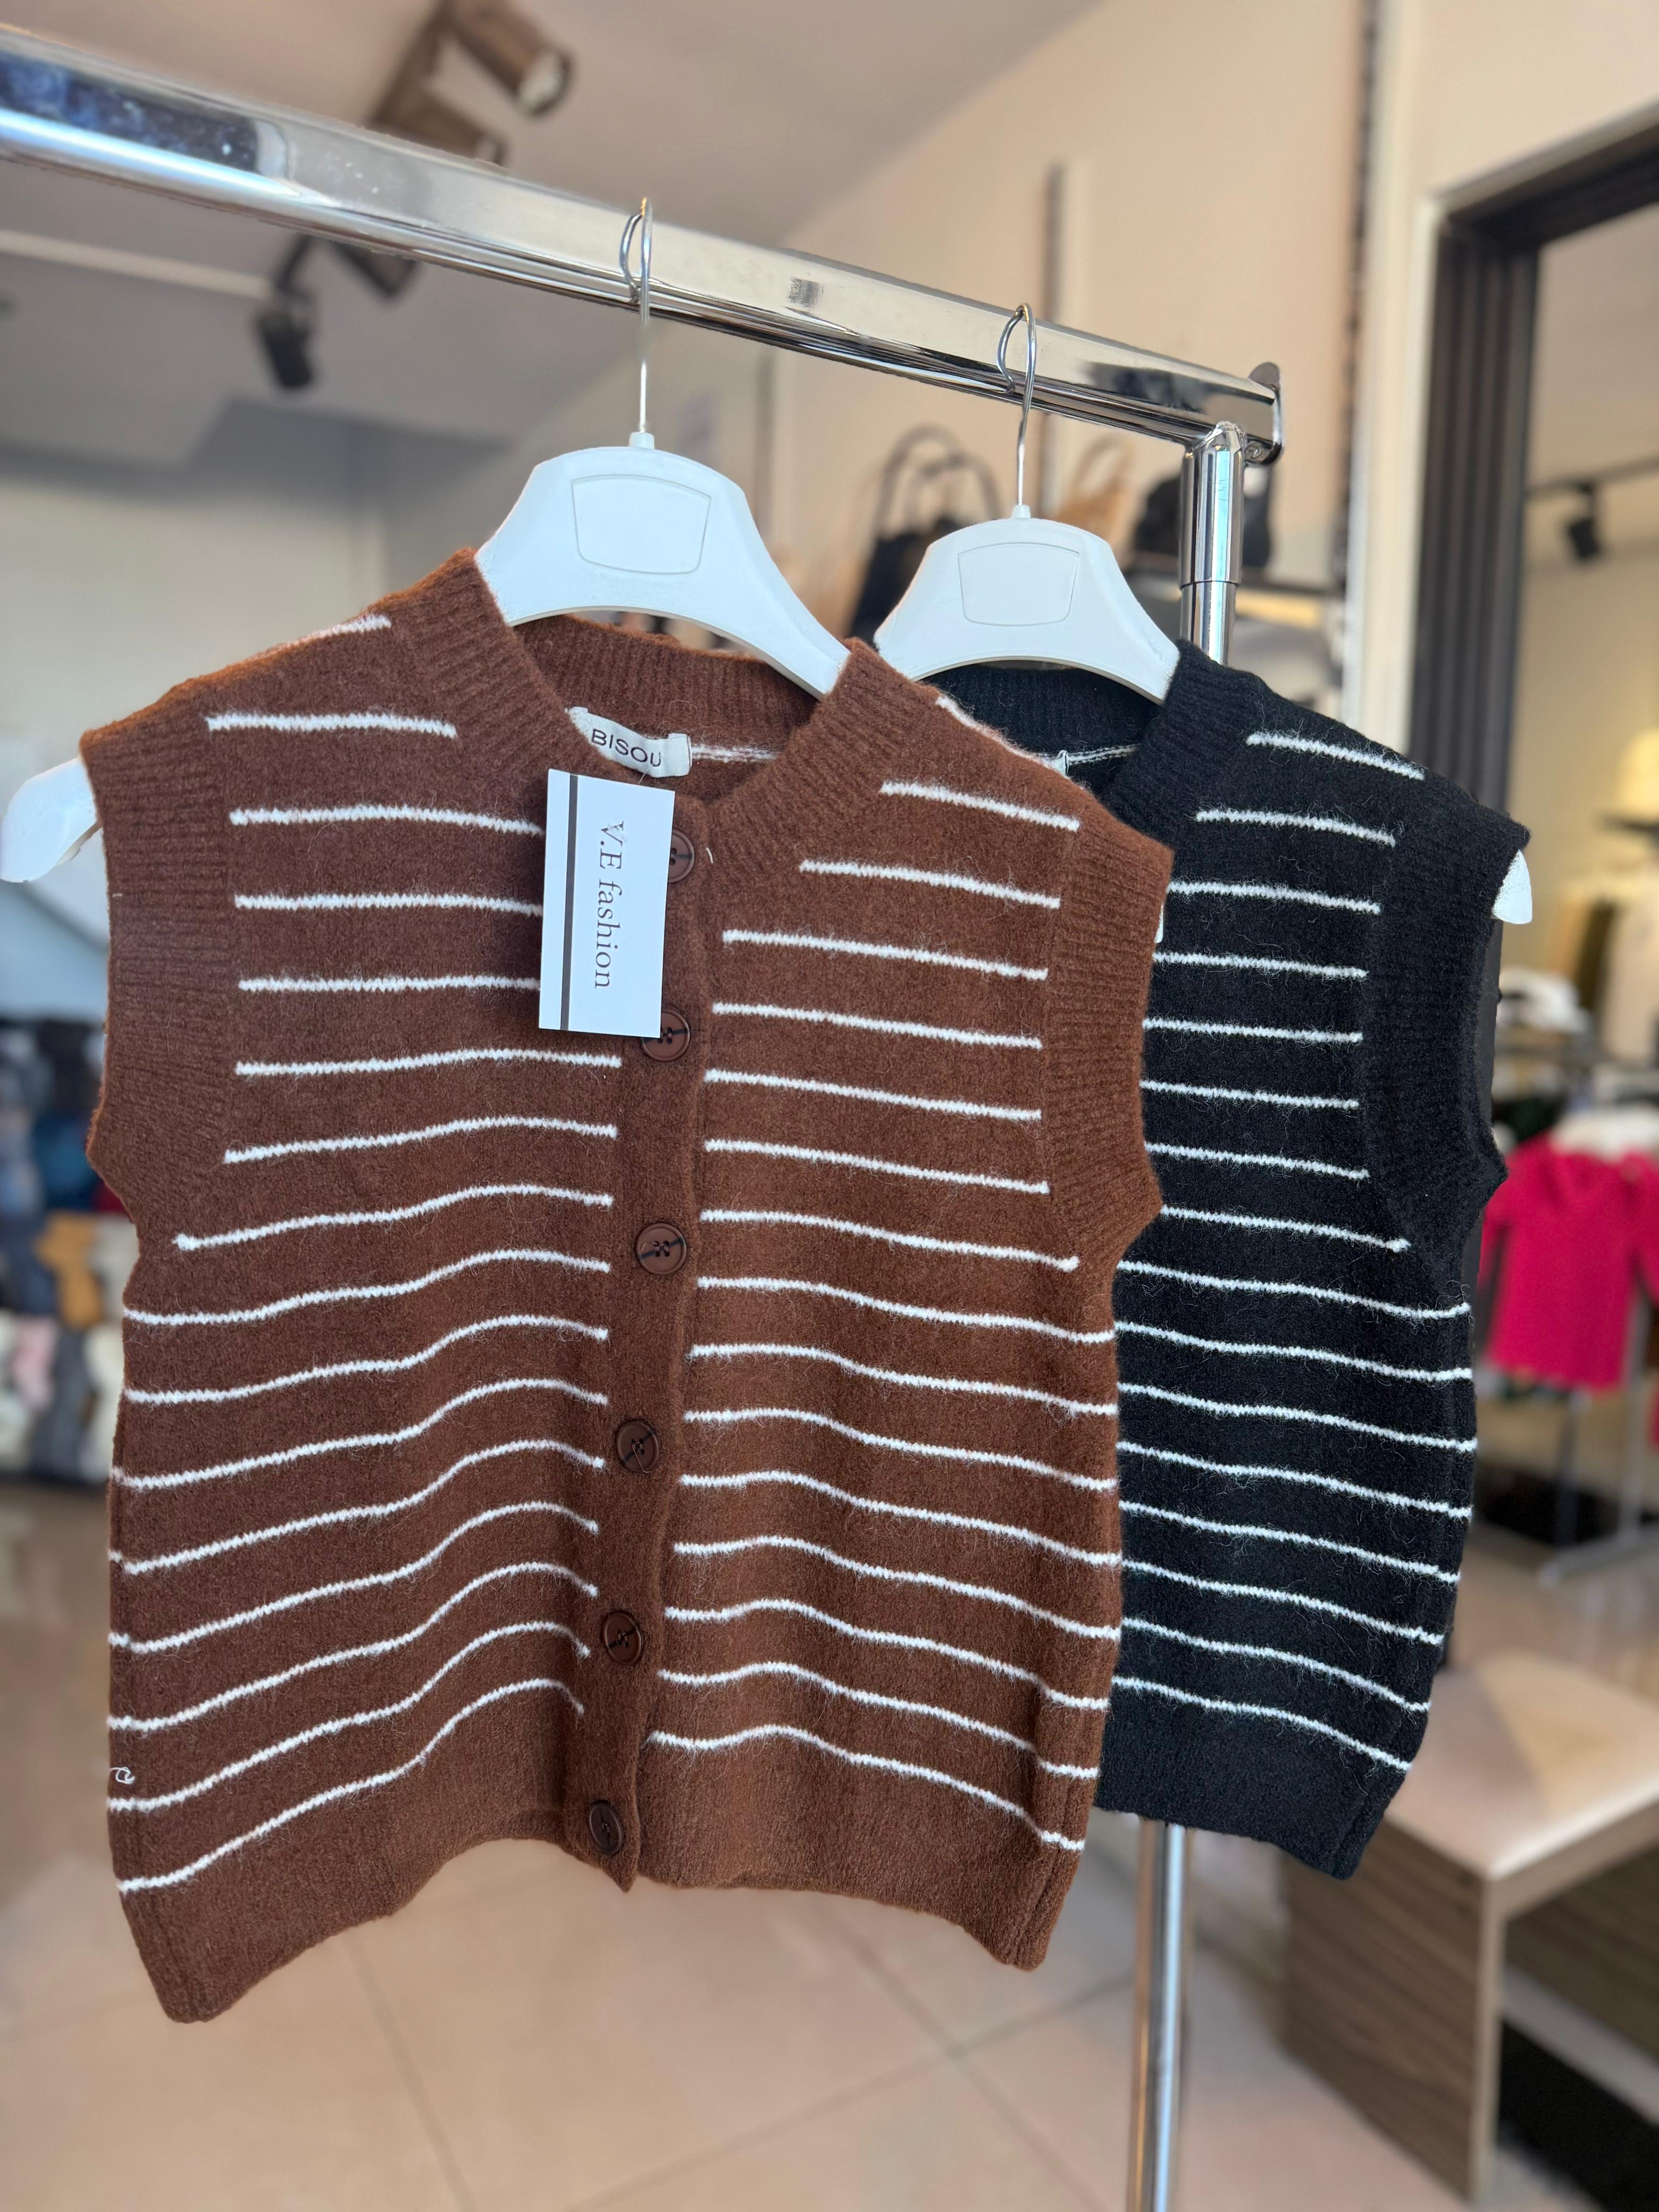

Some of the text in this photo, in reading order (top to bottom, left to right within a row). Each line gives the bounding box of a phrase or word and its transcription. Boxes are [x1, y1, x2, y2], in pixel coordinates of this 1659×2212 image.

[592, 728, 661, 767] BISOU
[594, 821, 624, 988] V.E fashion
